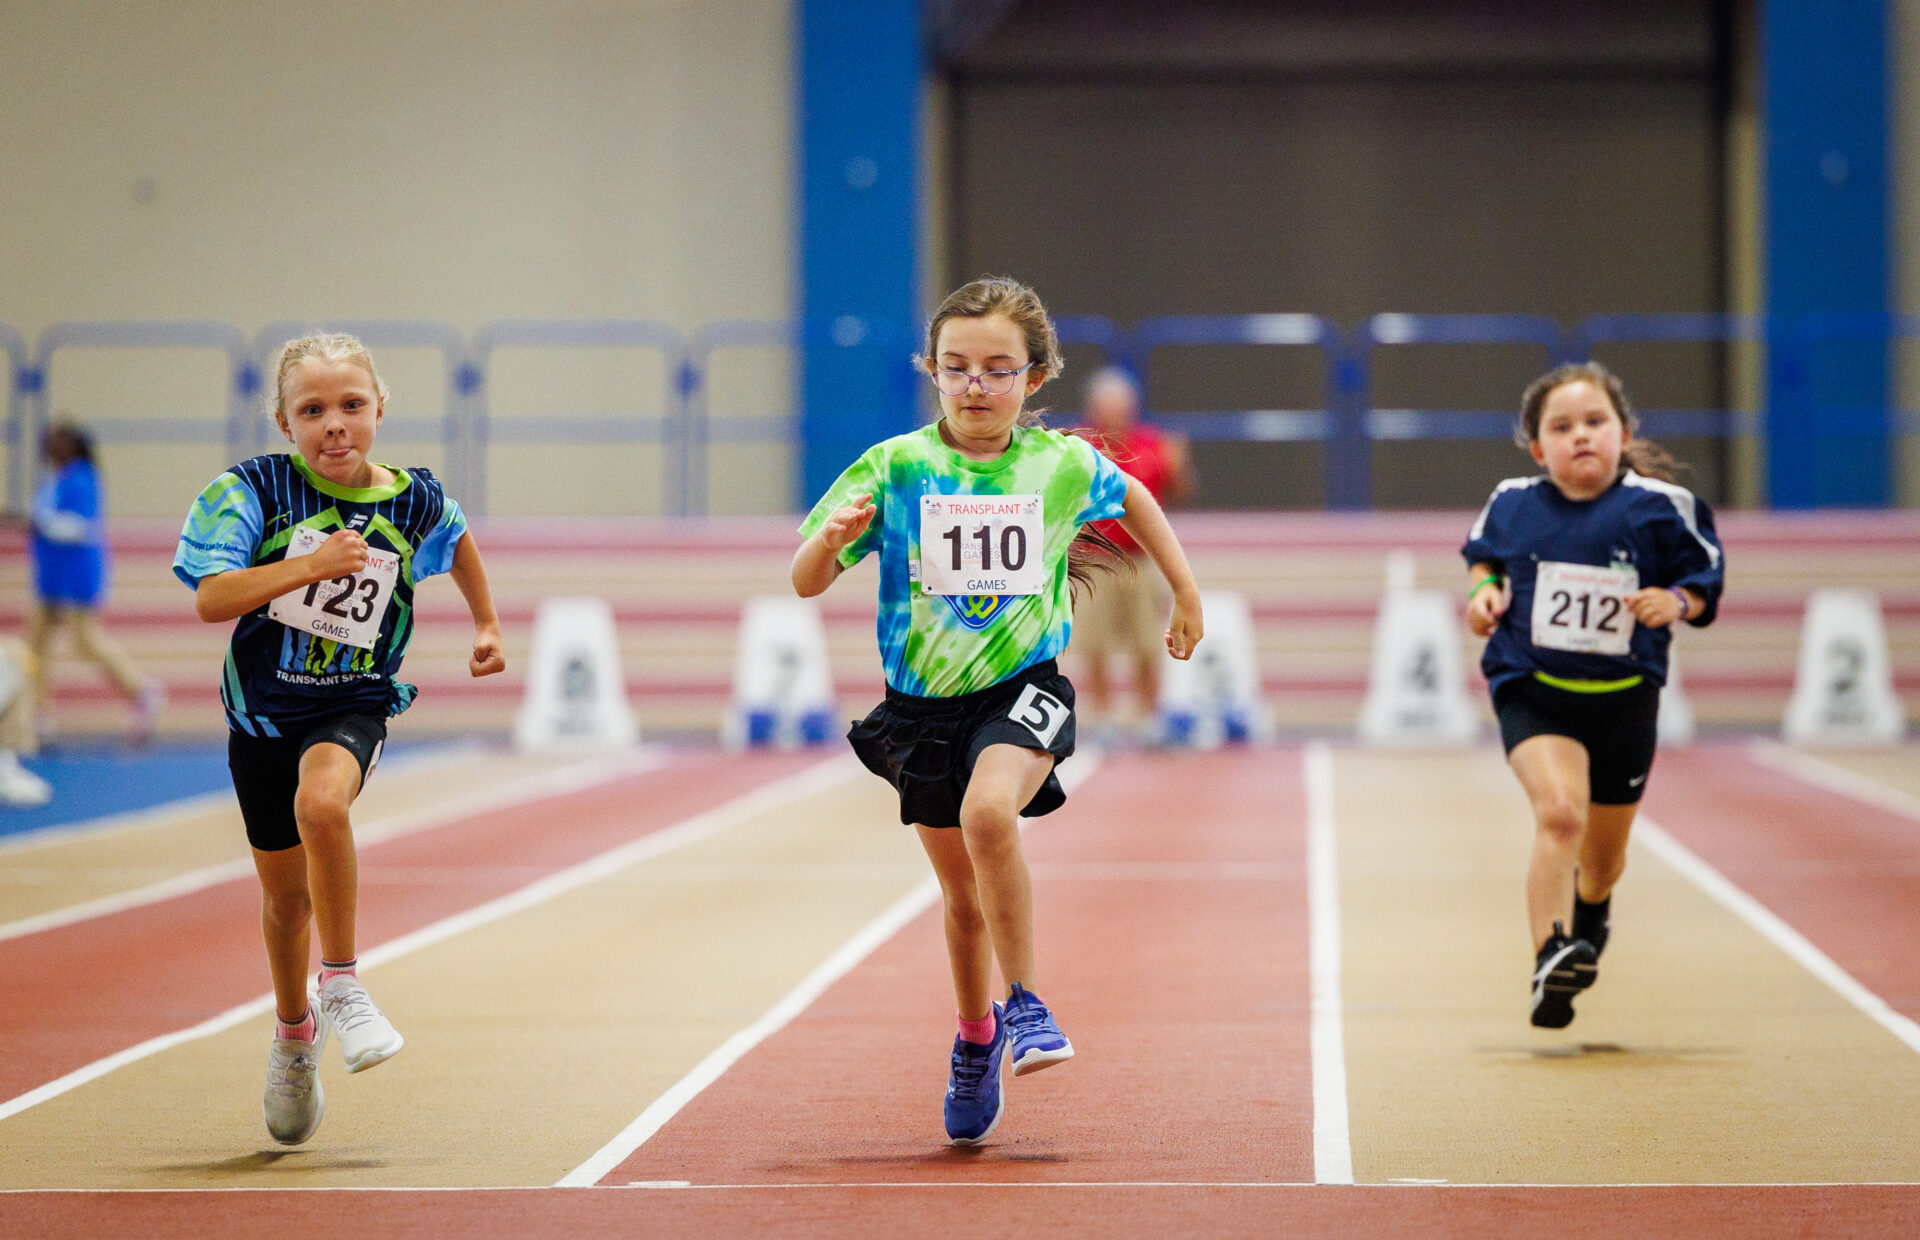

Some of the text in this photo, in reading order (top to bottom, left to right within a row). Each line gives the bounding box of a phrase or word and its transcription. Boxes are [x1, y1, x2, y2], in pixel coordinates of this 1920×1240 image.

[948, 504, 1021, 515] TRANSPLANT
[943, 525, 1027, 571] 110
[967, 580, 1007, 590] GAMES
[1550, 591, 1621, 632] 212
[311, 620, 351, 639] GAMES
[1021, 692, 1060, 732] 5
